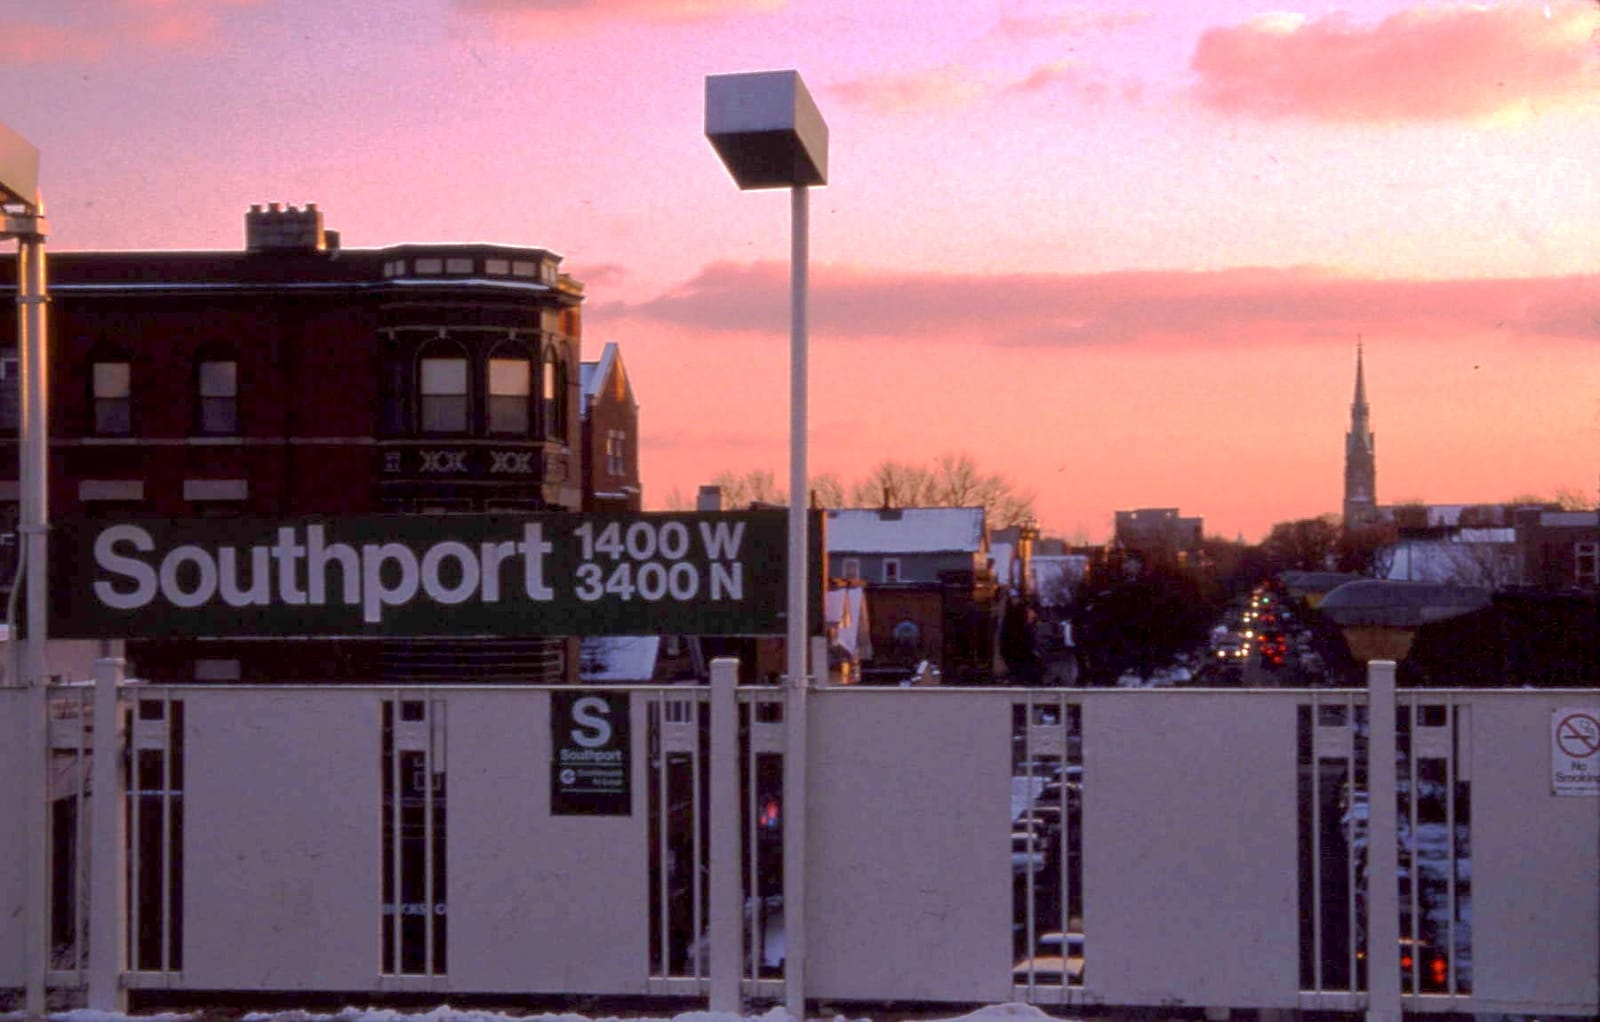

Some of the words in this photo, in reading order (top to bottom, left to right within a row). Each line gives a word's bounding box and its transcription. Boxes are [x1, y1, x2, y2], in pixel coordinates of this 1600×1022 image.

[573, 522, 690, 560] 1400
[700, 521, 746, 560] W
[93, 522, 554, 623] Southport
[575, 562, 699, 601] 3400
[710, 562, 744, 601] N
[570, 696, 612, 748] S
[560, 748, 622, 763] Southport
[1570, 761, 1588, 772] No
[1555, 772, 1600, 783] Smokin
